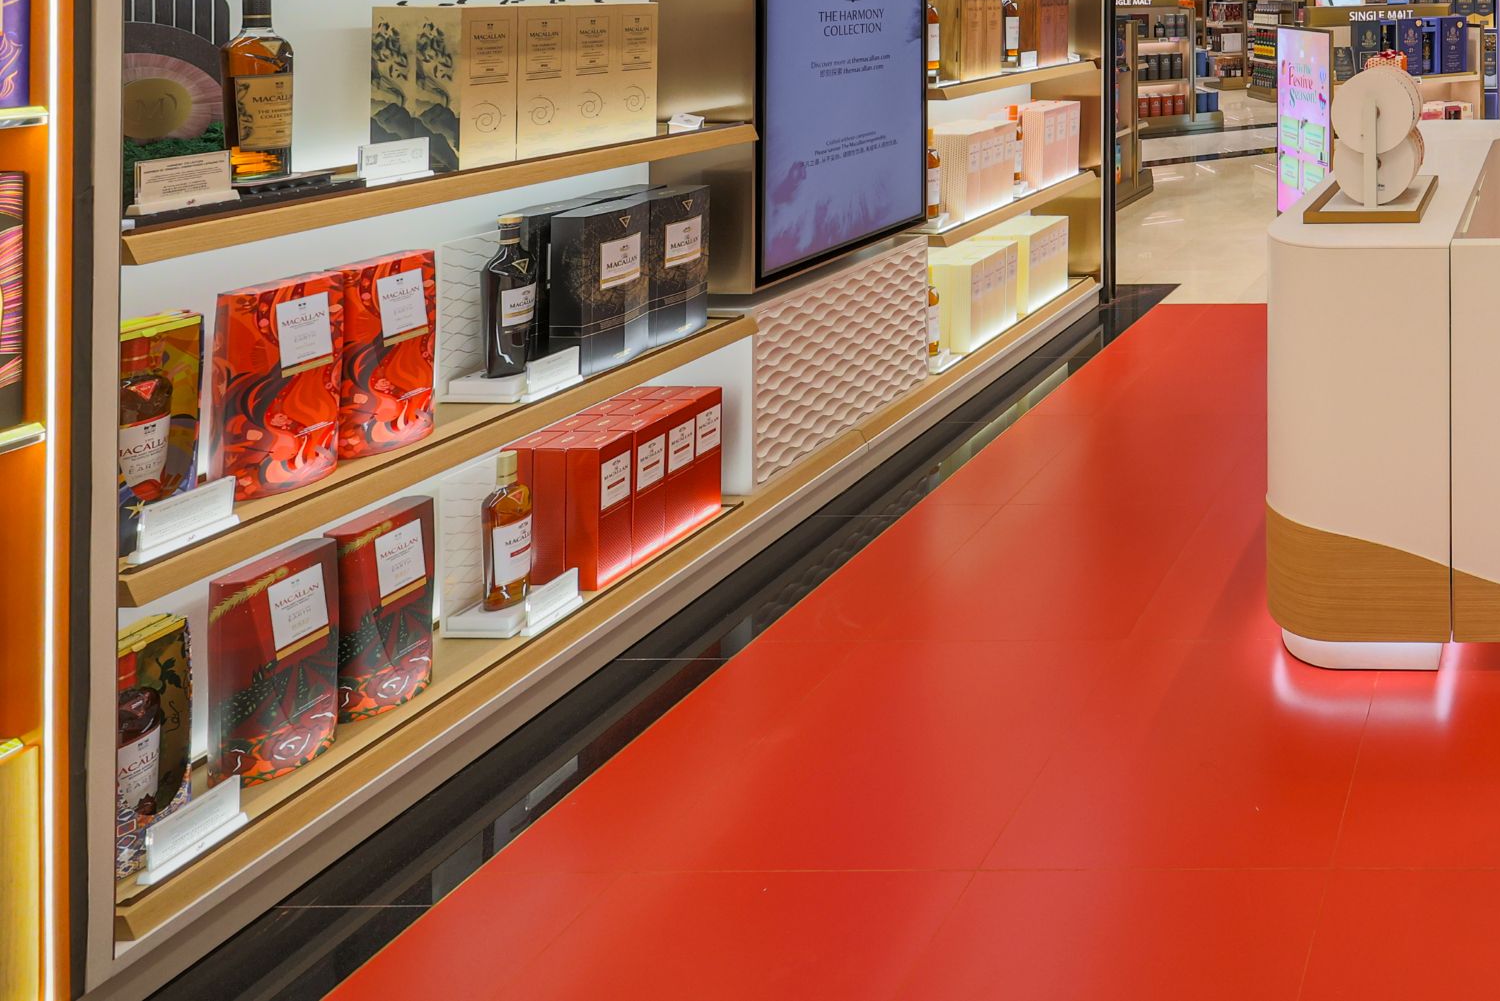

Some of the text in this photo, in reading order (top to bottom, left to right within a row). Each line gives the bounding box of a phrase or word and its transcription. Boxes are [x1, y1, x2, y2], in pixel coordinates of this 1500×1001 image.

[818, 8, 884, 22] THE HARMONY
[823, 22, 882, 37] COLLECTION
[851, 54, 891, 63] themacallan.com
[843, 64, 884, 74] themacallan.com
[1288, 62, 1313, 90] Festive
[1289, 87, 1317, 108] Season!
[670, 236, 699, 250] MACALLAN
[606, 255, 638, 269] MACALLAN
[382, 285, 420, 300] MACALLAN
[281, 311, 325, 327] MACALLAN
[380, 537, 418, 560] MACALLAN
[274, 582, 319, 609] MACALLAN
